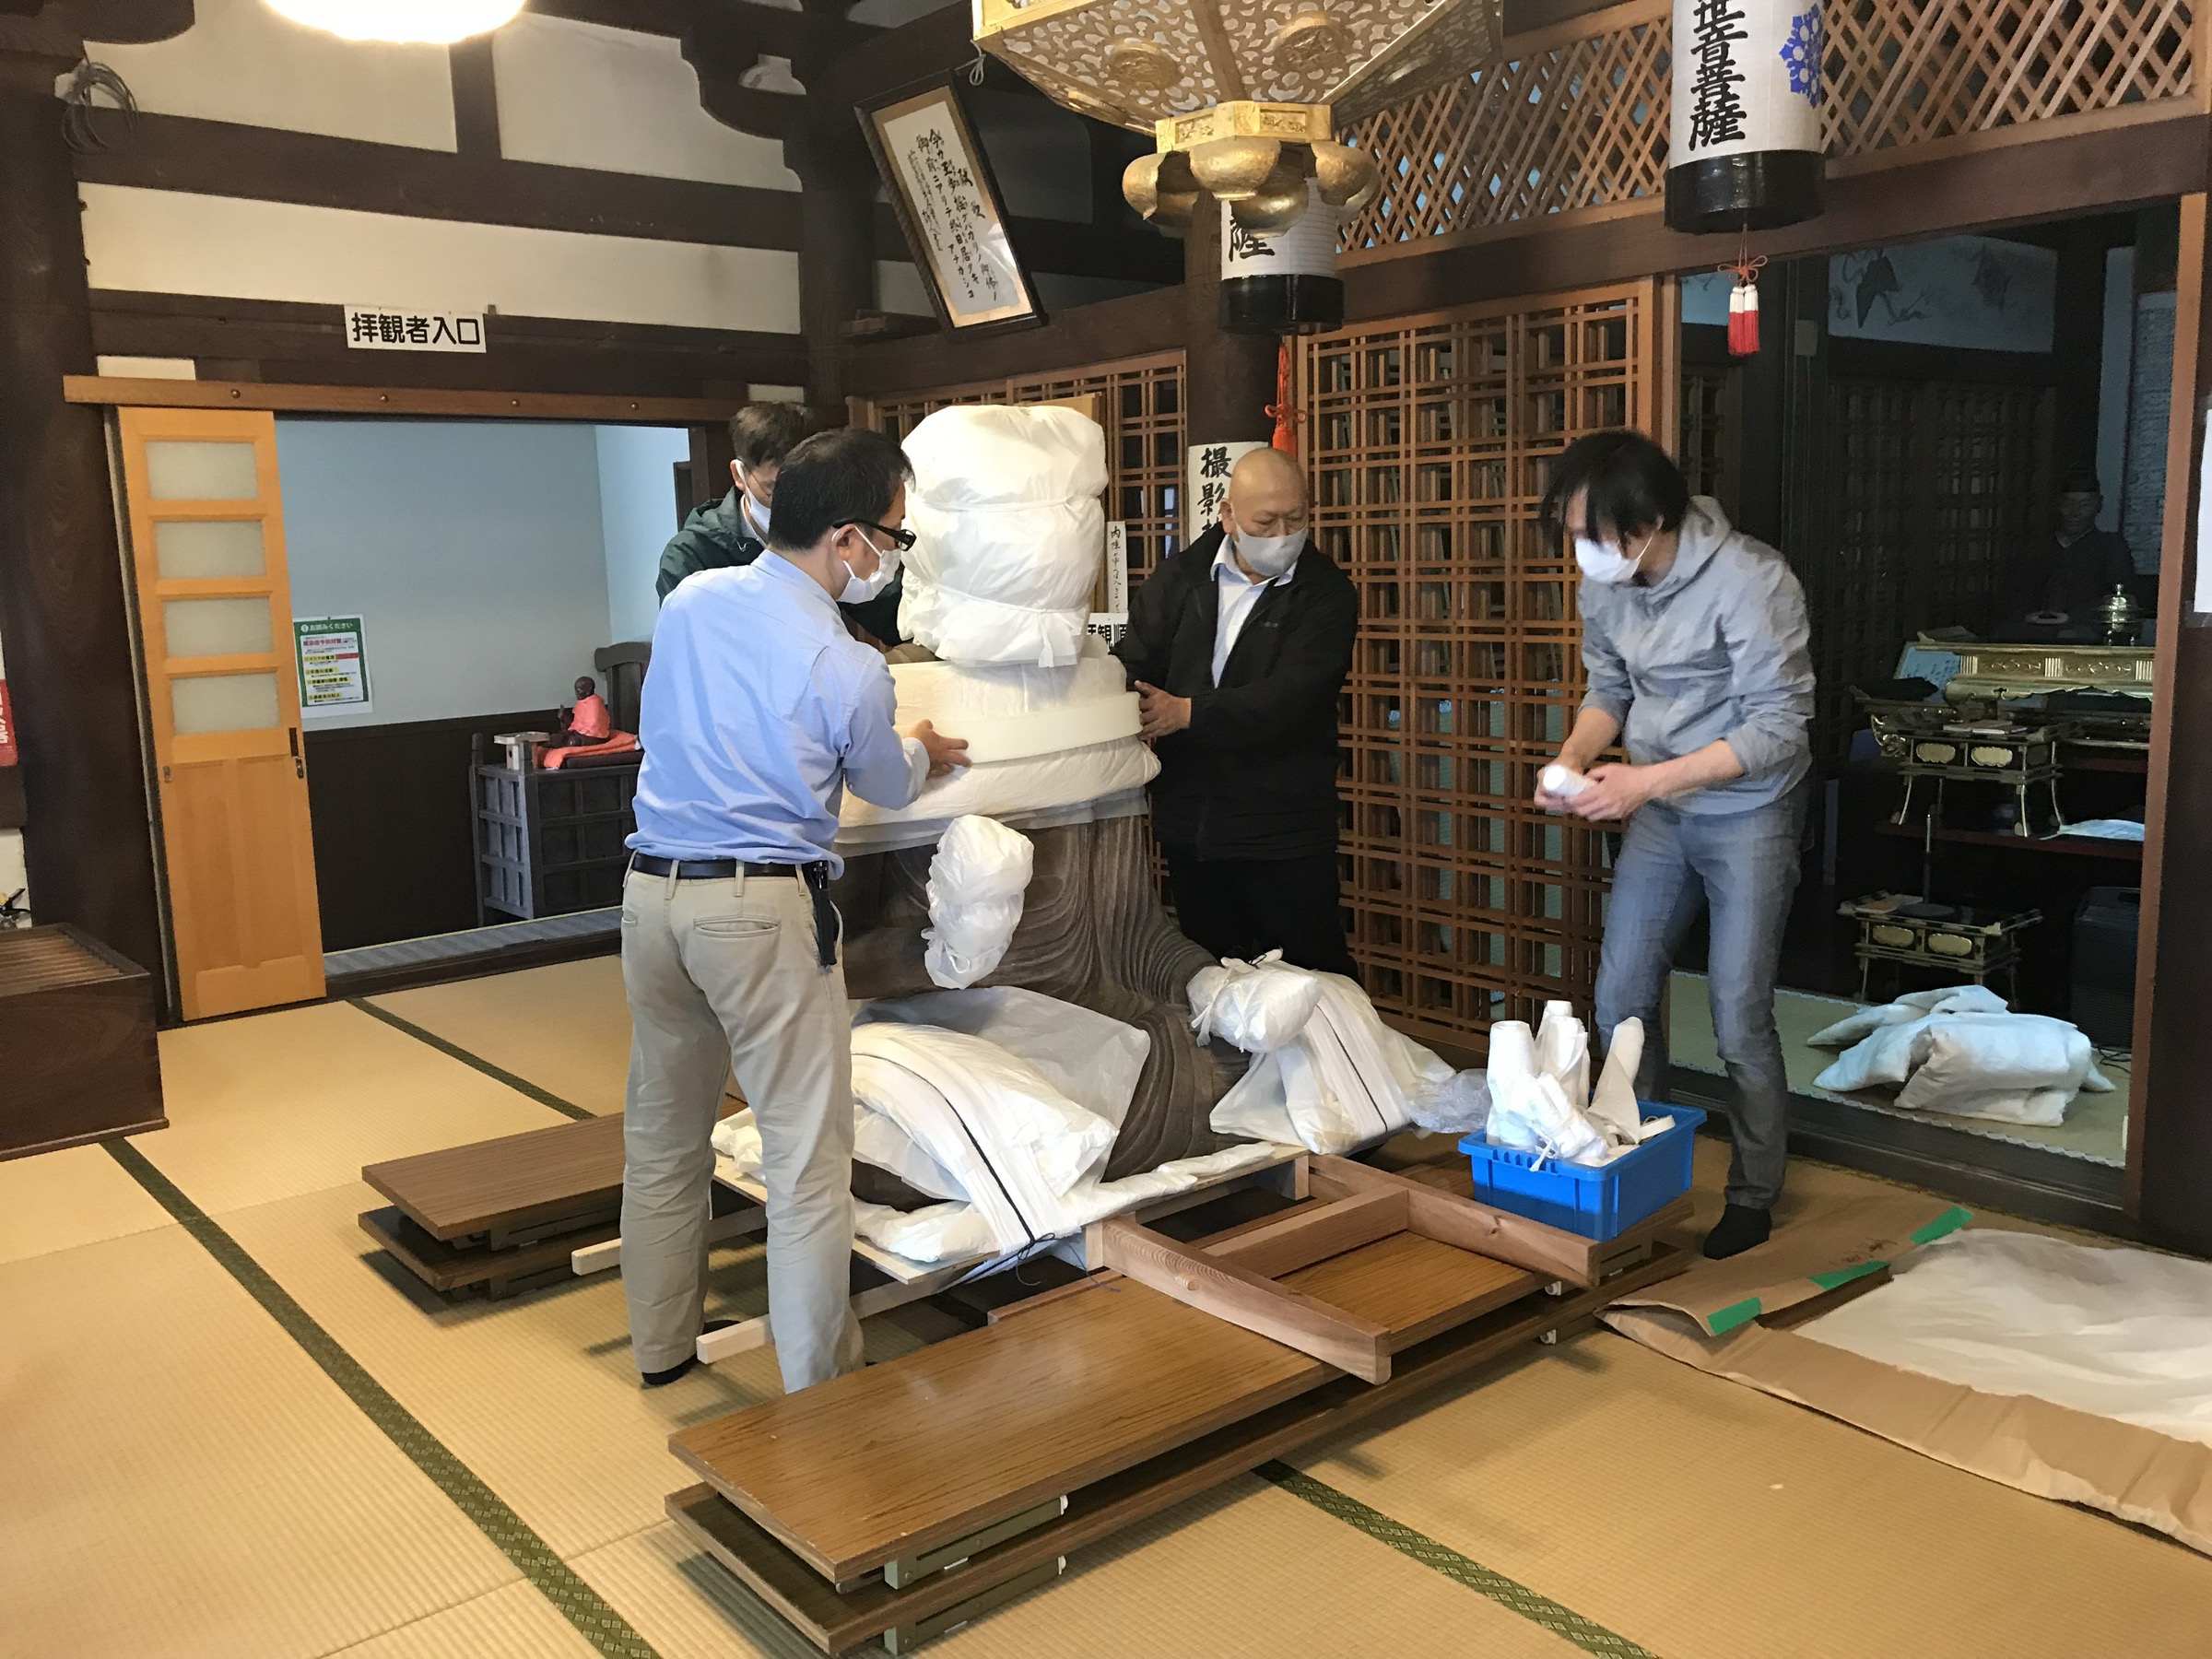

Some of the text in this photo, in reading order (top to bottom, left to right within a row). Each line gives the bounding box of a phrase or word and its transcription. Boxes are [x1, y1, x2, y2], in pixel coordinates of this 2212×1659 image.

[351, 312, 480, 345] 拝観者入口
[1196, 446, 1232, 532] 撮影
